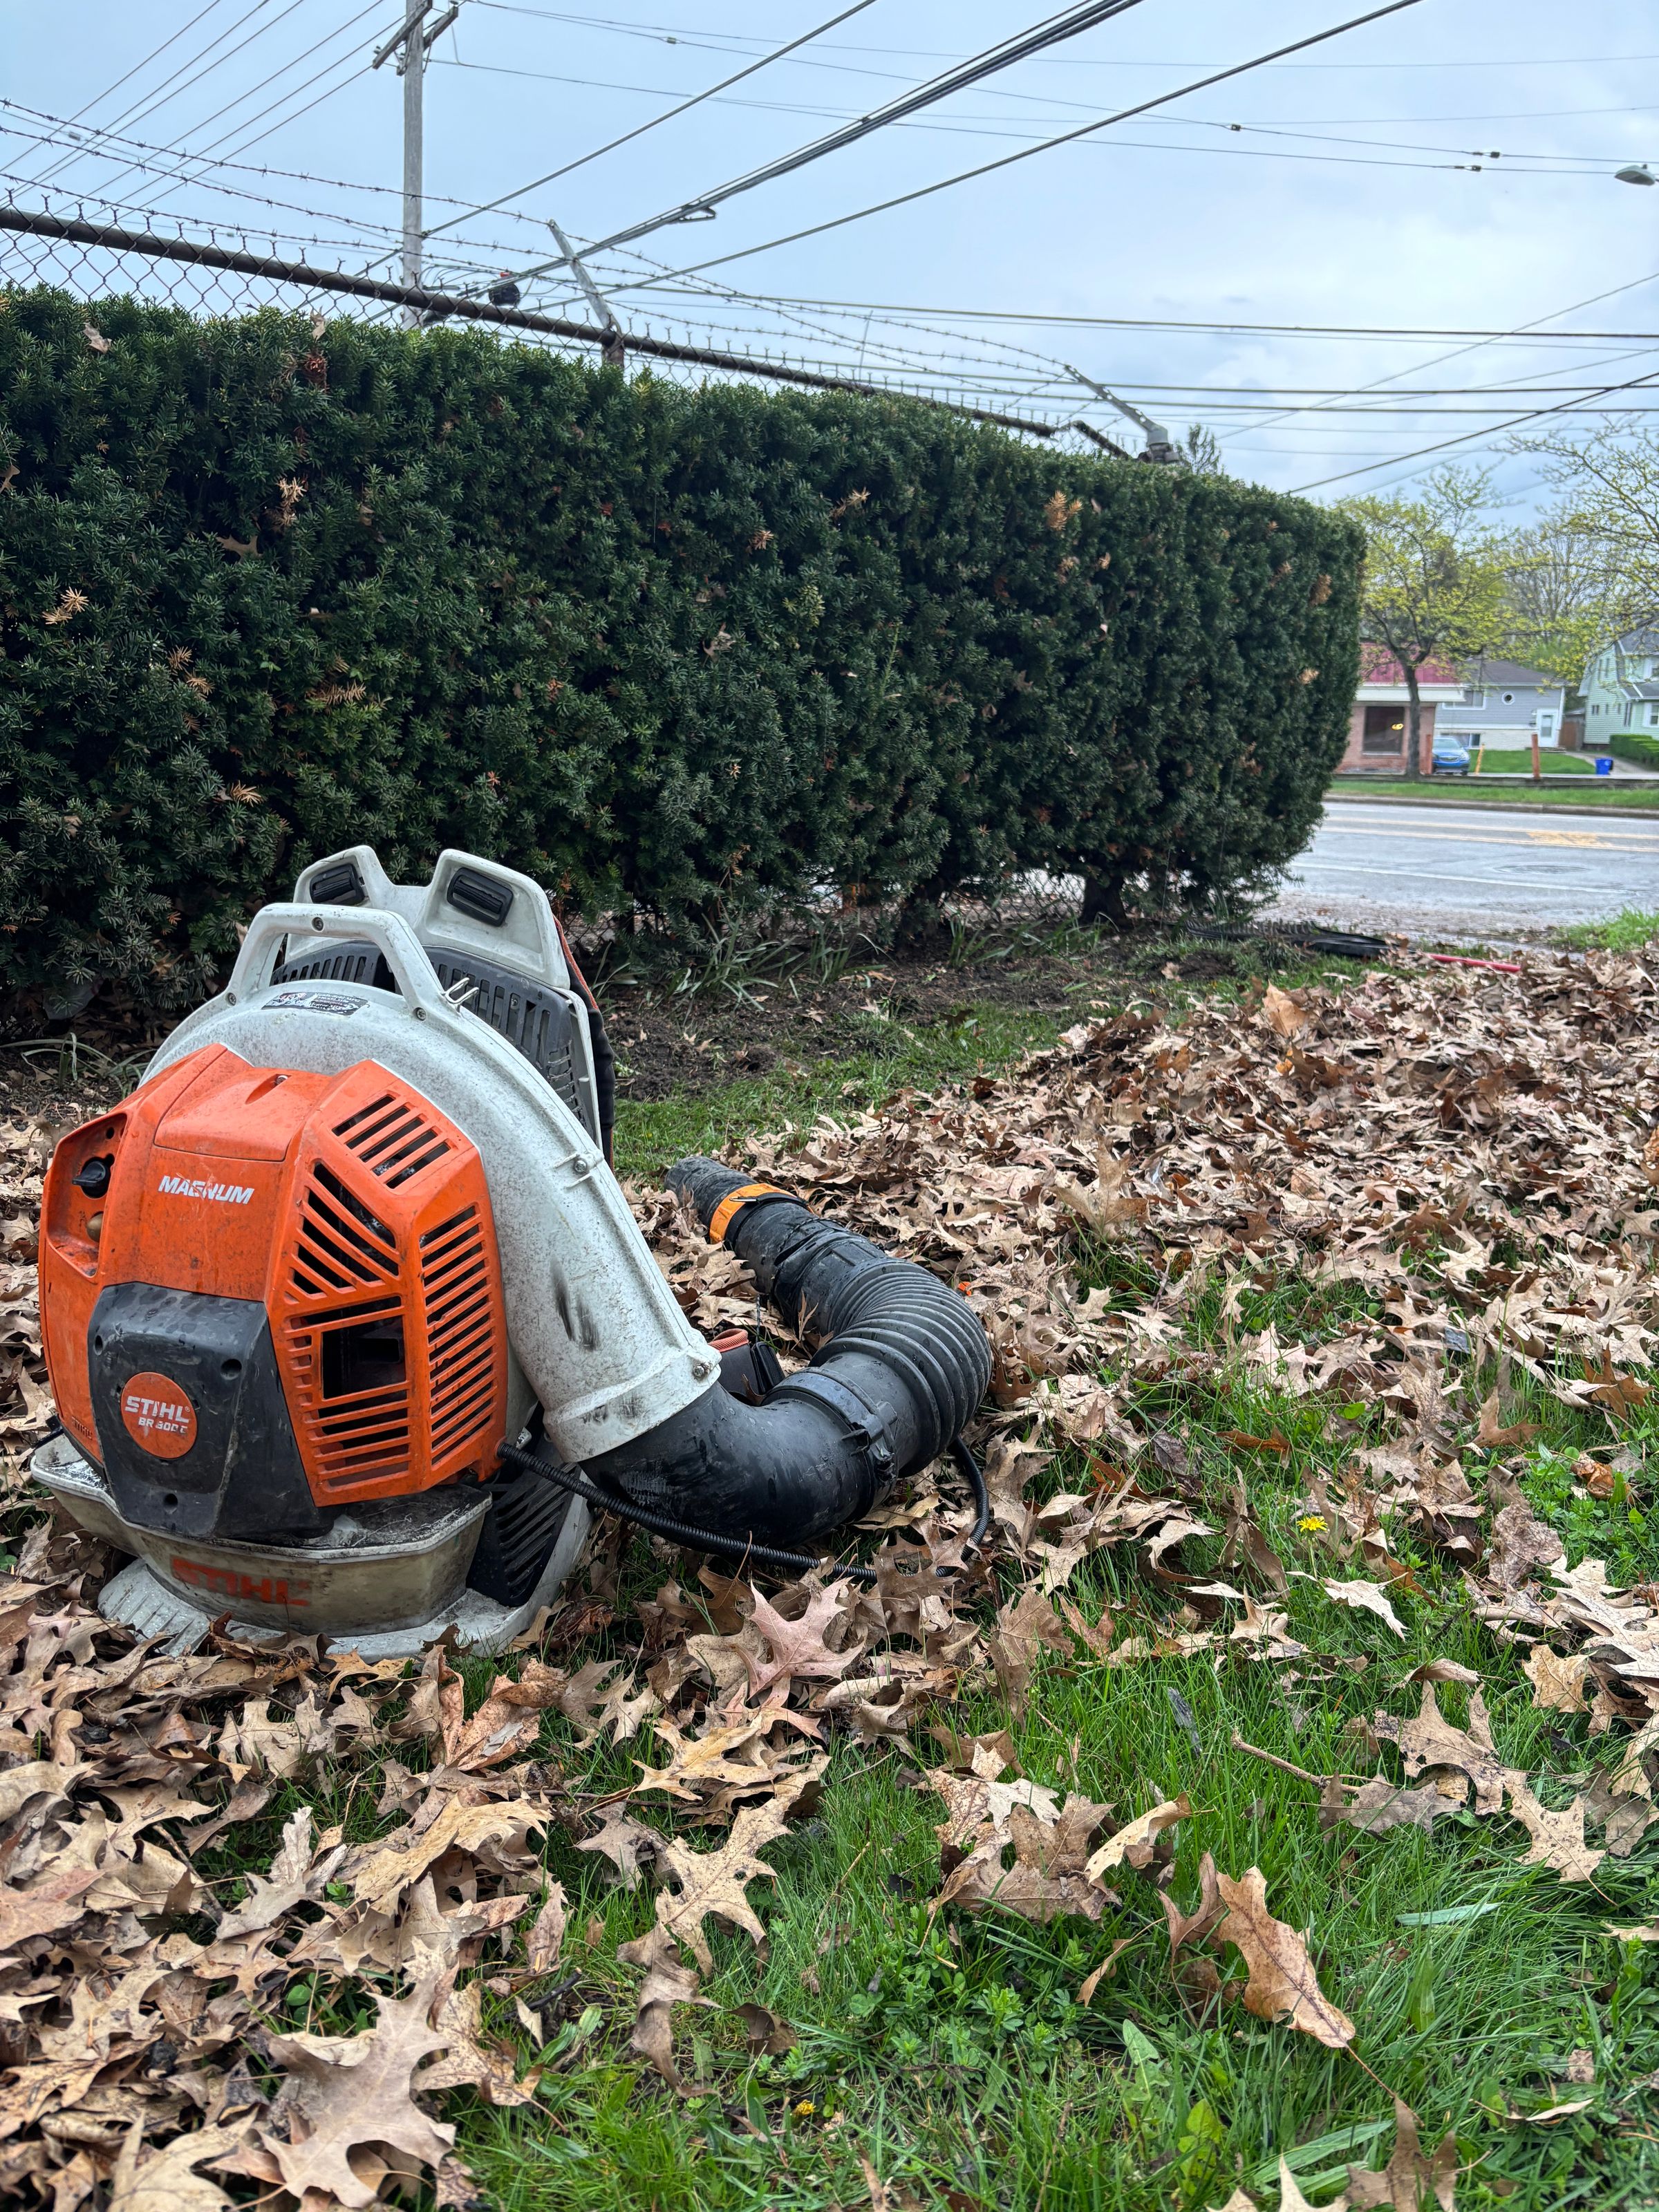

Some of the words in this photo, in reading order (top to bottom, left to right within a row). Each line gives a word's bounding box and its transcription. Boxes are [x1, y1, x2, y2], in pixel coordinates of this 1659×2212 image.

[158, 1175, 254, 1205] MAGNUM
[124, 1396, 189, 1423] STIHL
[138, 1417, 154, 1428] BR
[171, 1557, 309, 1607] STIHL
